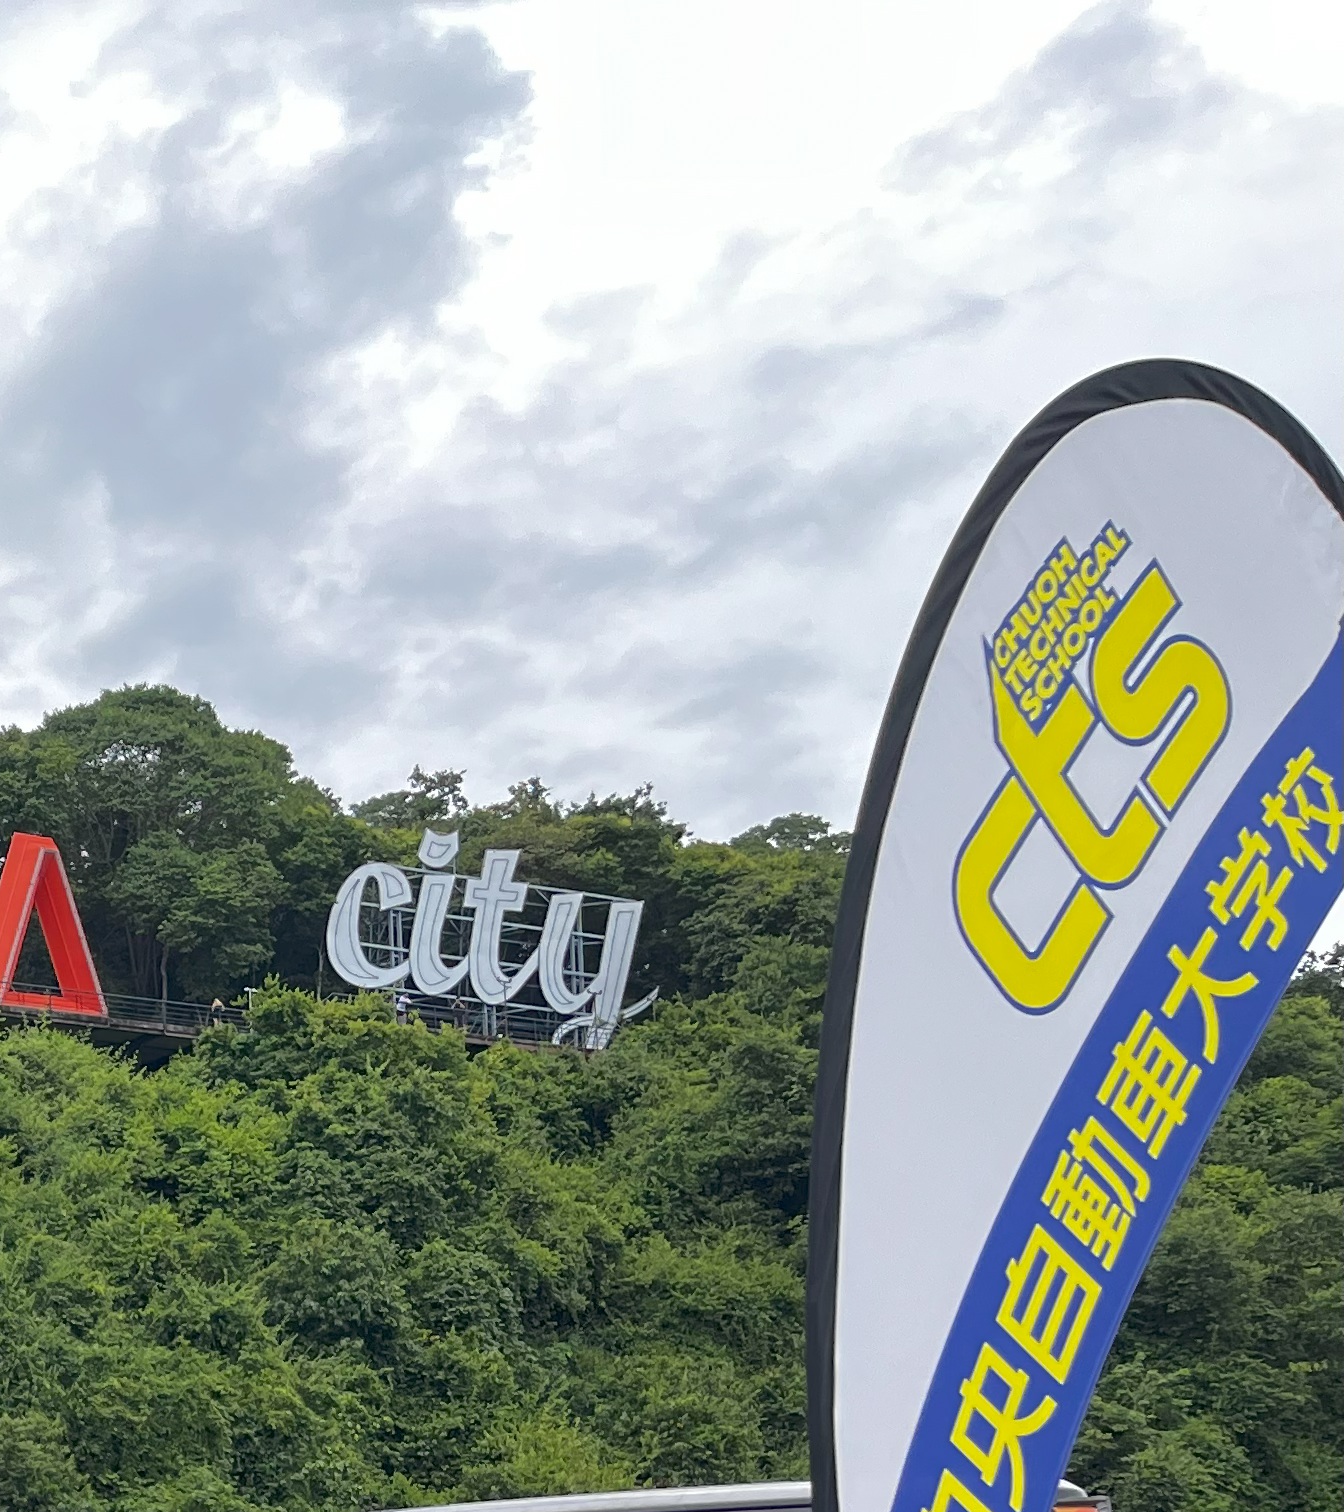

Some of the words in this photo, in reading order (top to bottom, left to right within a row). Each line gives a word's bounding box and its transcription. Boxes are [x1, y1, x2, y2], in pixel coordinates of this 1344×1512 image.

[990, 542, 1080, 672] CHUOH
[1003, 523, 1129, 698] TECHNICAL
[1019, 587, 1119, 723] SCHOOL
[324, 829, 660, 1051] city
